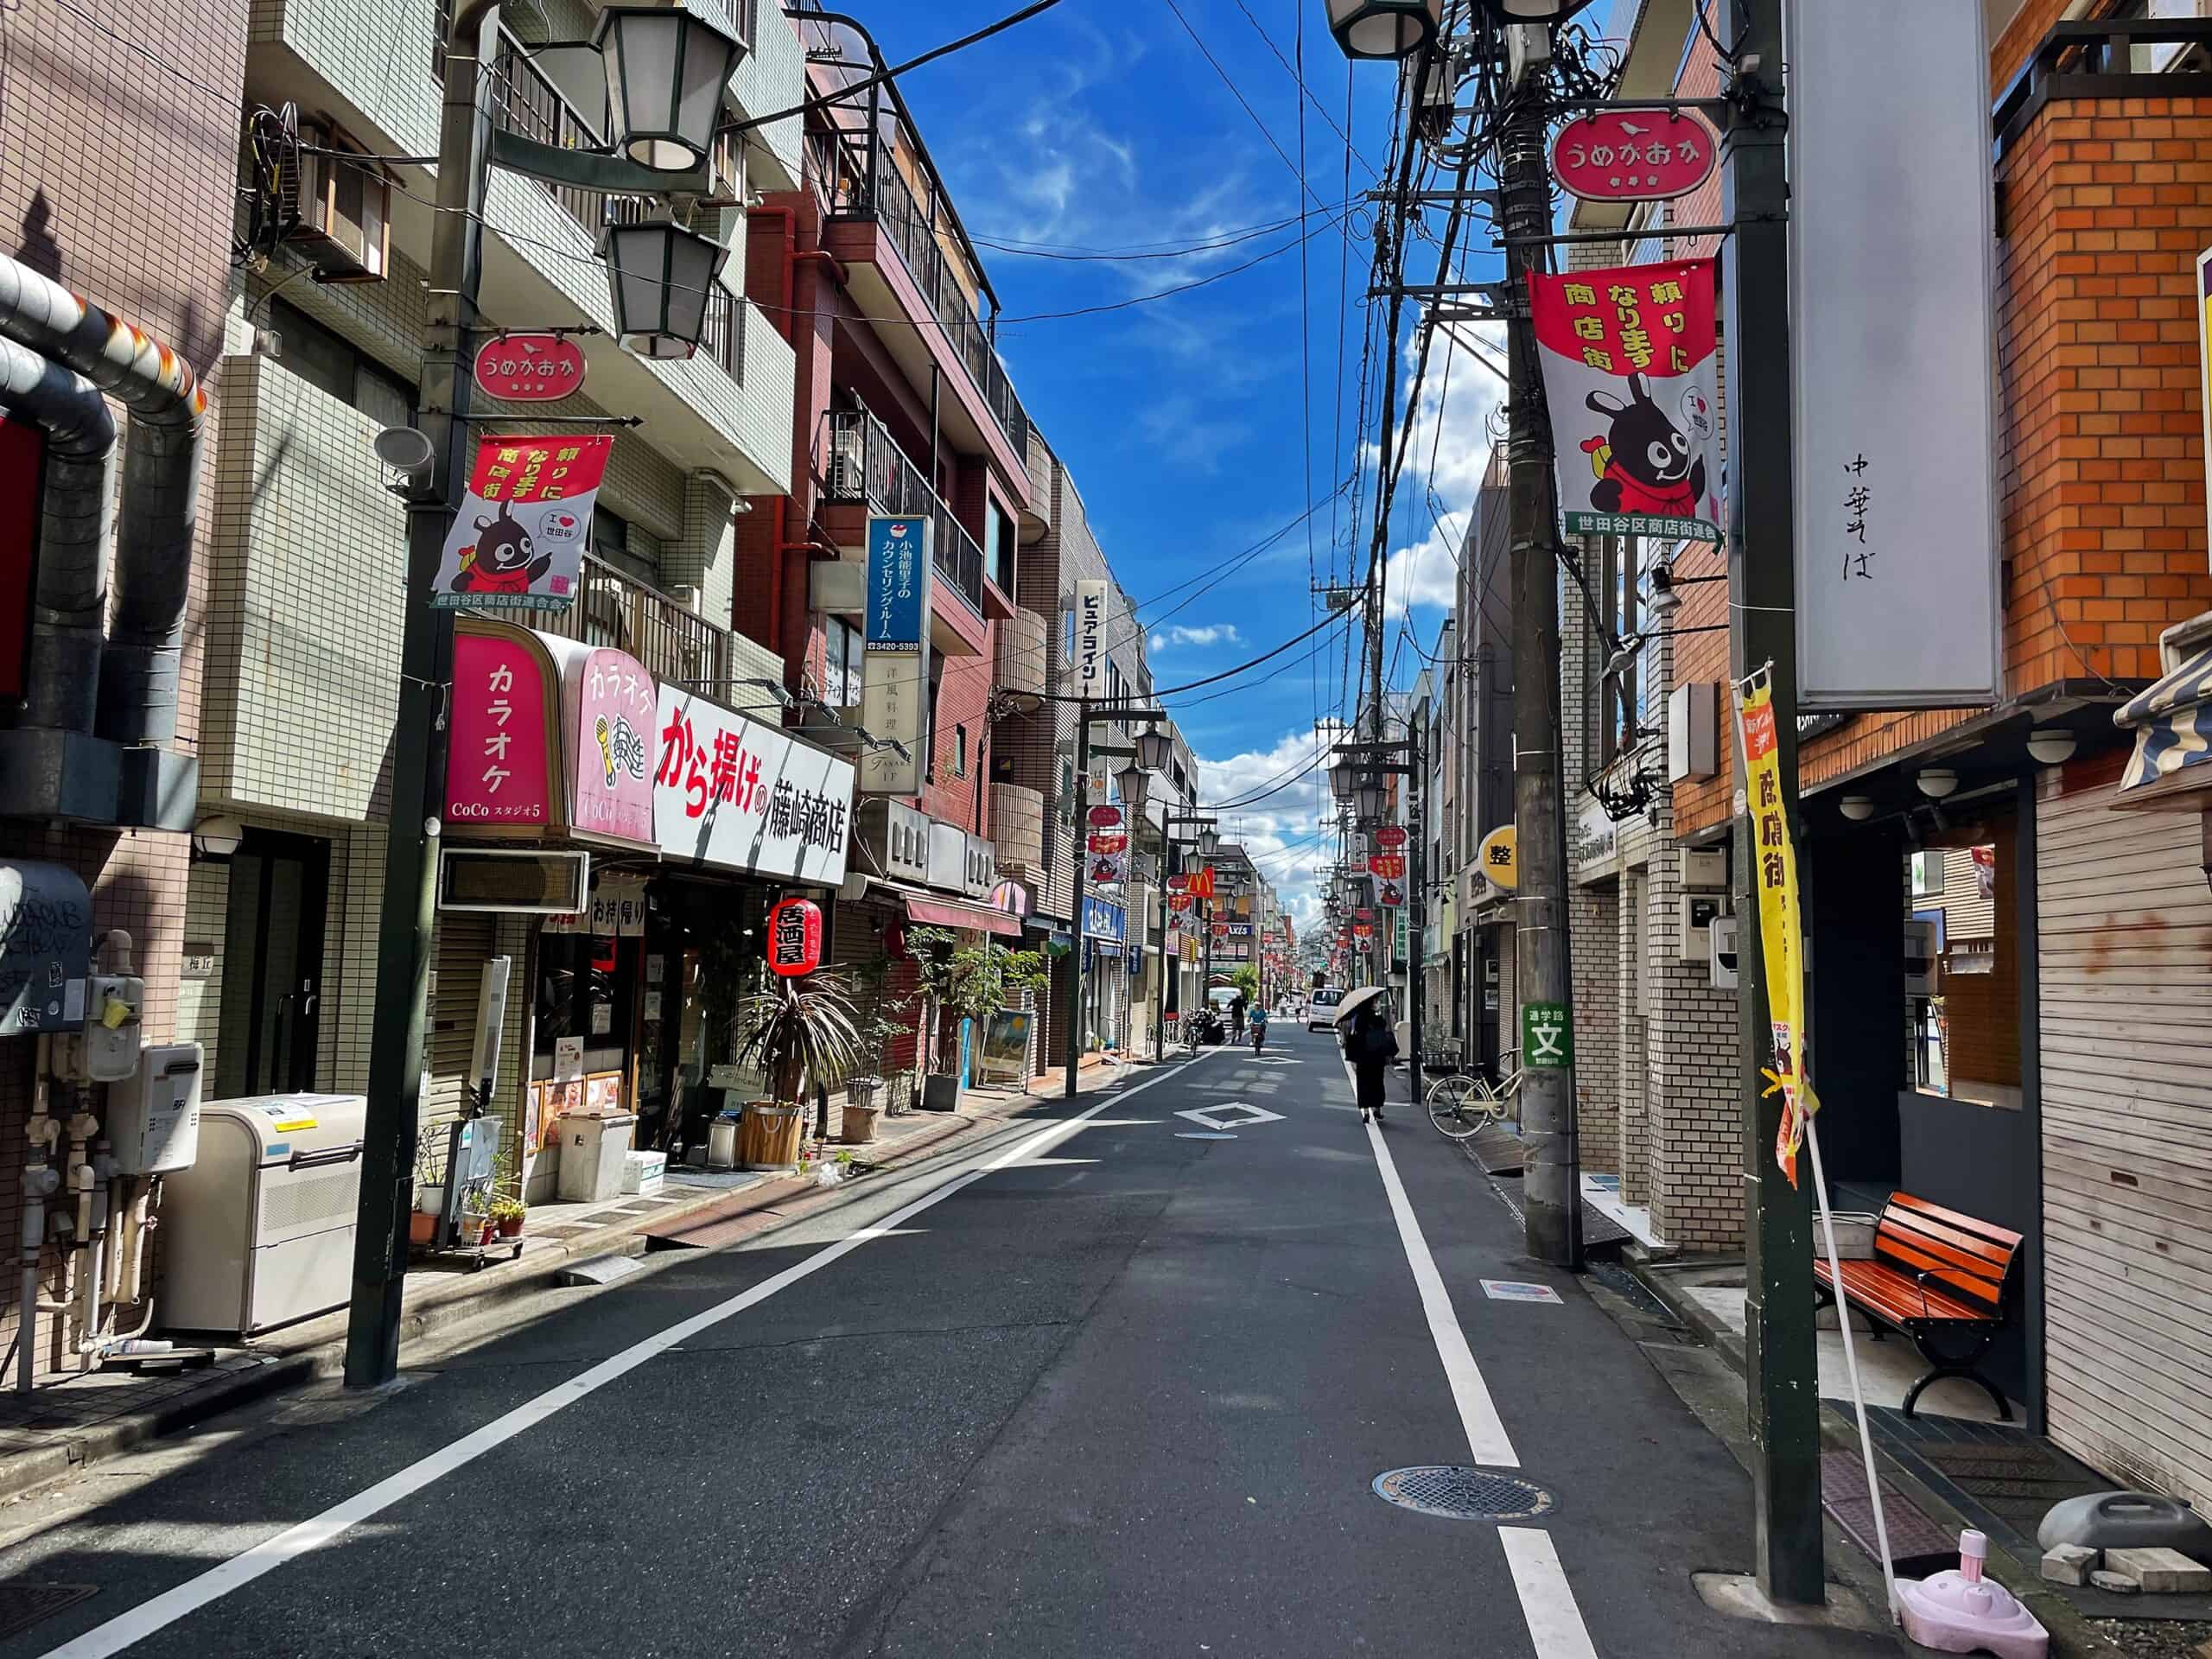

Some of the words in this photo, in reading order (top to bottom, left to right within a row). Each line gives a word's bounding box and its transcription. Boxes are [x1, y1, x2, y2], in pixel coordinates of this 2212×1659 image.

[1563, 283, 1613, 372] 商店街
[1608, 283, 1655, 369] なります
[1649, 282, 1689, 372] 頼りに
[482, 448, 519, 499] 商店街
[511, 448, 549, 498] なります
[539, 447, 580, 499] 頼りに
[546, 526, 573, 538] 世田谷
[1578, 514, 1718, 540] 世田谷区商店街連合
[1842, 452, 1876, 582] 中華そば
[876, 642, 918, 651] 3420-5393
[590, 664, 653, 715] カラオケ
[481, 664, 513, 794] カラオケ
[452, 803, 489, 817] CoCo
[1490, 845, 1511, 866] 整
[777, 906, 804, 964] 居酒屋
[1529, 1009, 1564, 1021] 通学路
[1531, 1022, 1563, 1056] 文
